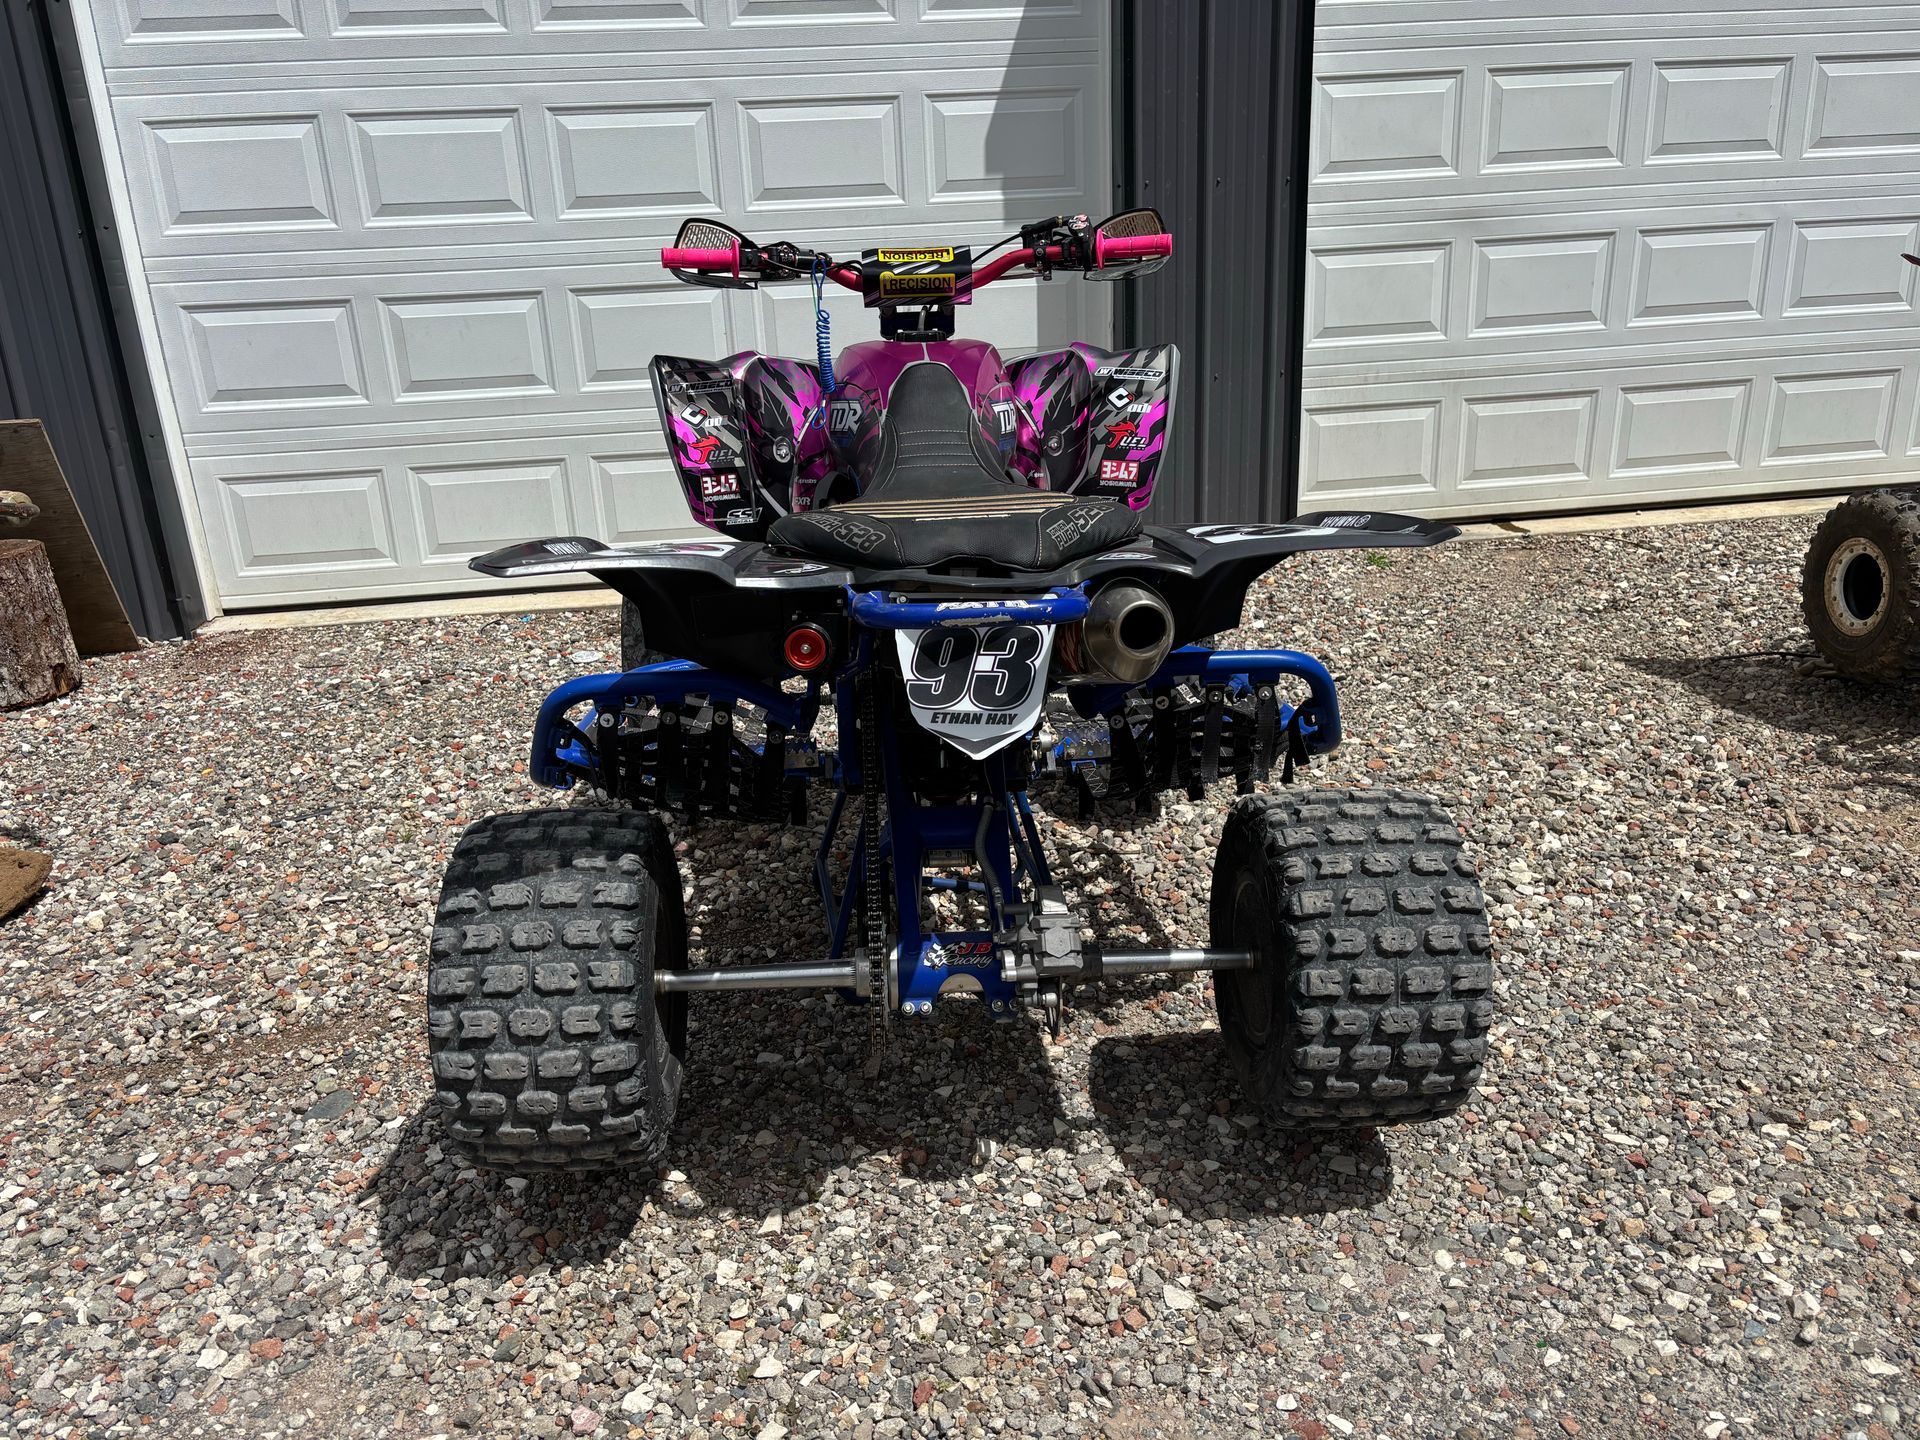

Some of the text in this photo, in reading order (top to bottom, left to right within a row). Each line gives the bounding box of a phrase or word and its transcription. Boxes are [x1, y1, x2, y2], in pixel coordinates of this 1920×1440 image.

[1099, 480, 1137, 488] YOSHIMURA
[906, 624, 1043, 711] 93
[930, 711, 1018, 726] ETHAN HAY
